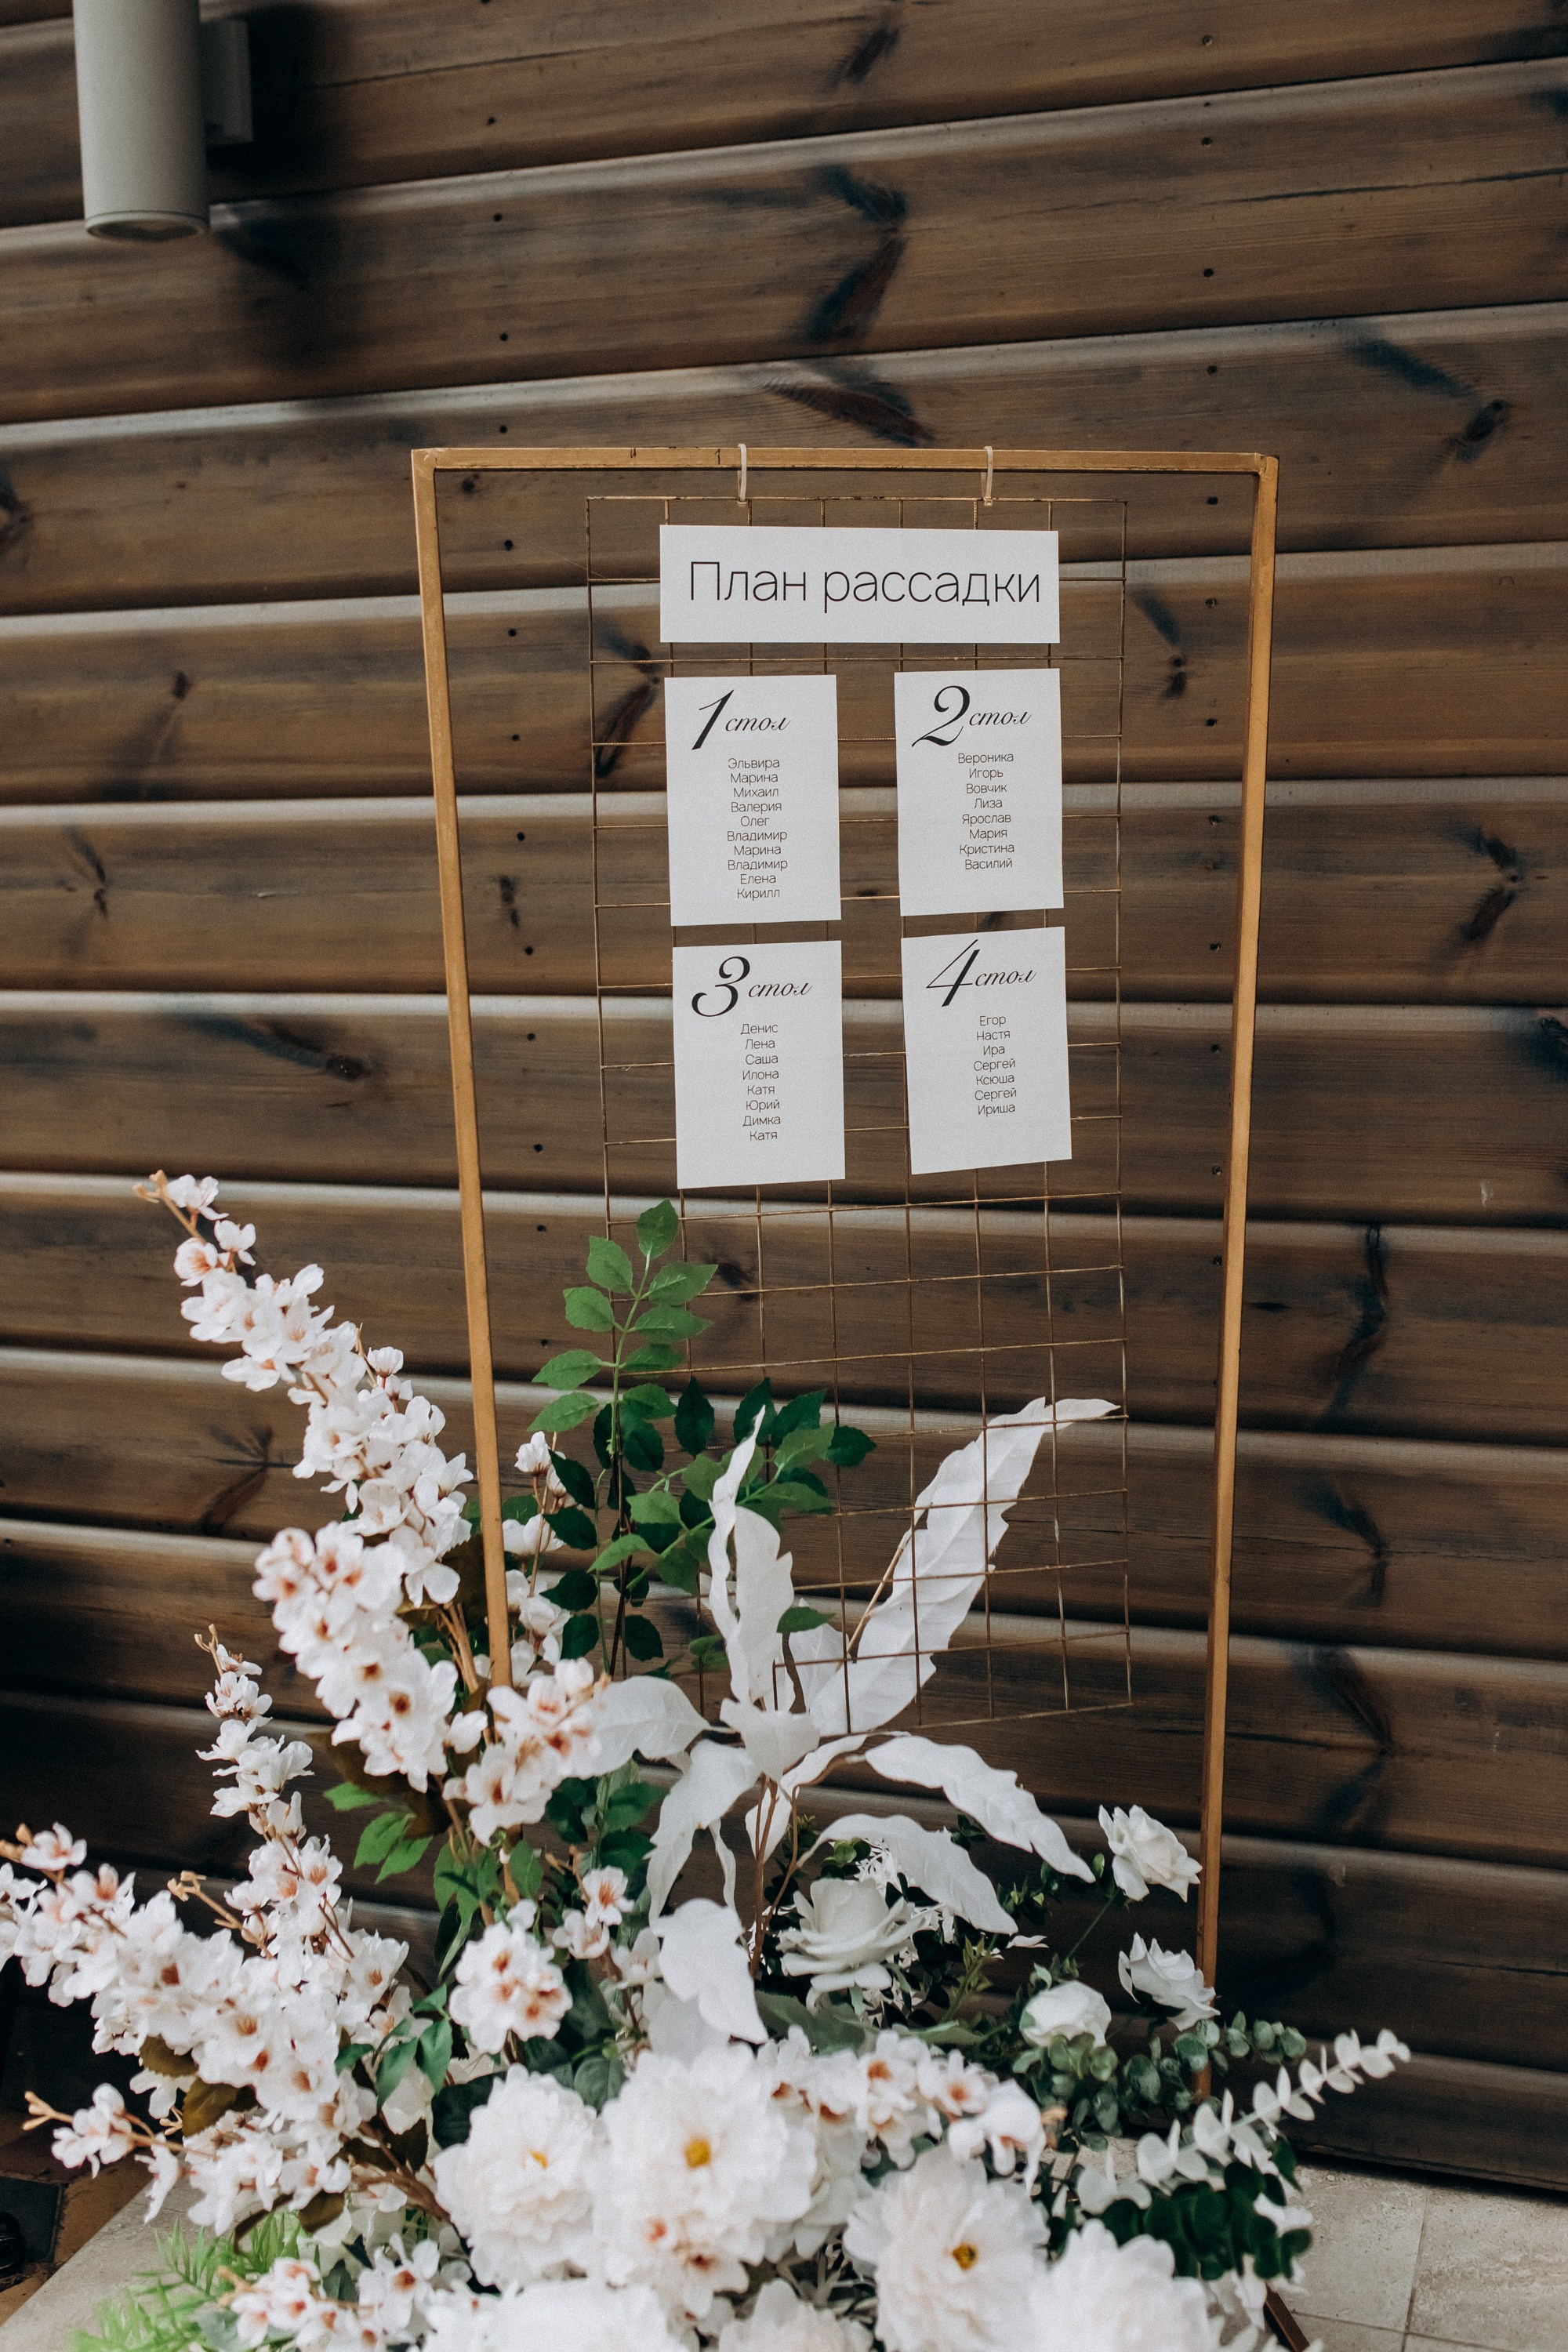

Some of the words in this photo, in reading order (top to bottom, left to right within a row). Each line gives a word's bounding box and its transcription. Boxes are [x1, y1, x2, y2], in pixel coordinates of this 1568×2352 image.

[690, 561, 807, 602] План
[824, 571, 1040, 614] рассадки
[691, 688, 735, 751] 1
[724, 716, 791, 732] стол
[911, 684, 971, 748] 2
[969, 710, 1033, 727] стол
[728, 757, 780, 771] Эльвира
[957, 753, 1014, 766] Вероника
[730, 772, 779, 786] Марина
[969, 768, 1004, 781] Игорь
[733, 786, 779, 798] Михаил
[966, 782, 1007, 794] Вовчик
[731, 801, 782, 815] Валерия
[973, 797, 1004, 809] Лиза
[740, 815, 771, 827] Олег
[961, 813, 1011, 828] Ярослав
[727, 830, 788, 843] Владимир
[969, 828, 1007, 842] Мария
[733, 844, 782, 858] Марина
[959, 844, 1015, 858] Кристина
[728, 859, 789, 872] Владимир
[964, 857, 1013, 870] Василий
[740, 873, 777, 885] Елена
[737, 888, 780, 902] Кирилл
[925, 938, 981, 1007] 4
[974, 968, 1038, 986] стол
[691, 956, 751, 1018] 3
[748, 982, 813, 998] стол
[979, 1015, 1007, 1028] Егор
[740, 1023, 779, 1036] Денис
[975, 1030, 1011, 1042] Настя
[744, 1038, 775, 1050] Лена
[982, 1044, 1006, 1058] Ира
[745, 1053, 779, 1065] Саша
[973, 1058, 1016, 1073] Сергей
[742, 1069, 779, 1080] Илона
[975, 1074, 1015, 1086] Ксюша
[746, 1084, 775, 1096] Катя
[974, 1087, 1018, 1102] Сергей
[745, 1098, 781, 1113] Юрий
[977, 1104, 1016, 1118] Ириша
[742, 1115, 782, 1127] Димка
[750, 1131, 779, 1142] Катя
